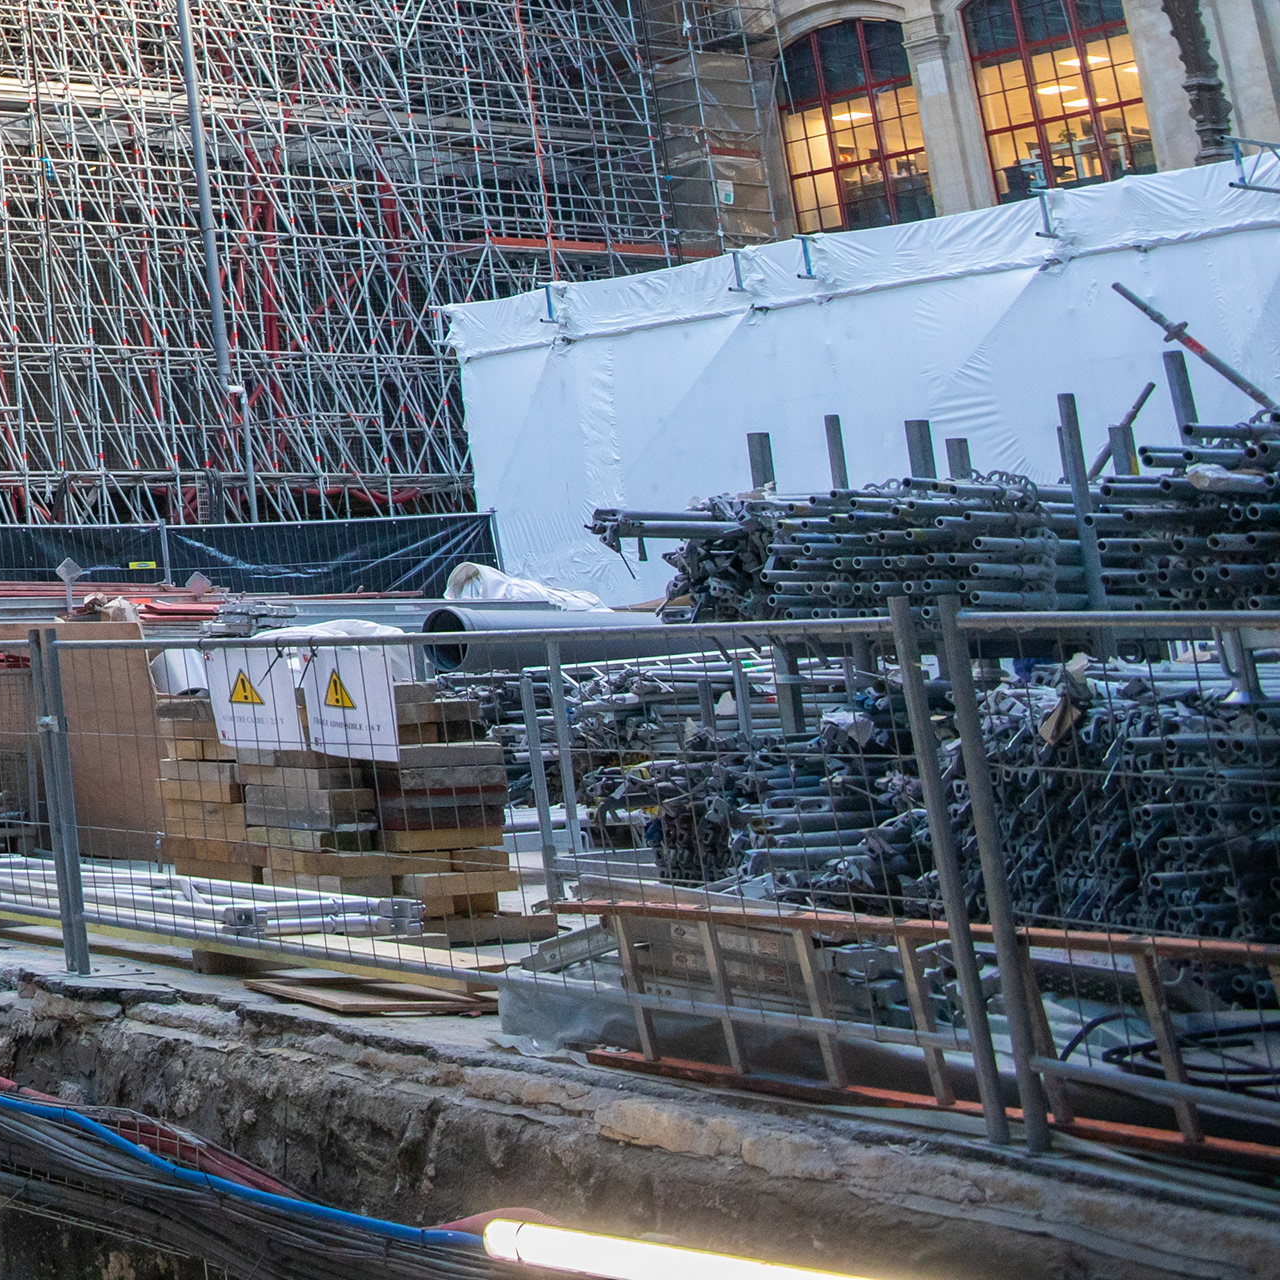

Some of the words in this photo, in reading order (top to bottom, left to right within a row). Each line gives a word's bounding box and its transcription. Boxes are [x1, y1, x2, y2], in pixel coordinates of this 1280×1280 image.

[246, 716, 265, 725] CARE
[313, 717, 329, 727] CHGE
[330, 720, 363, 731] ADMIIBLE
